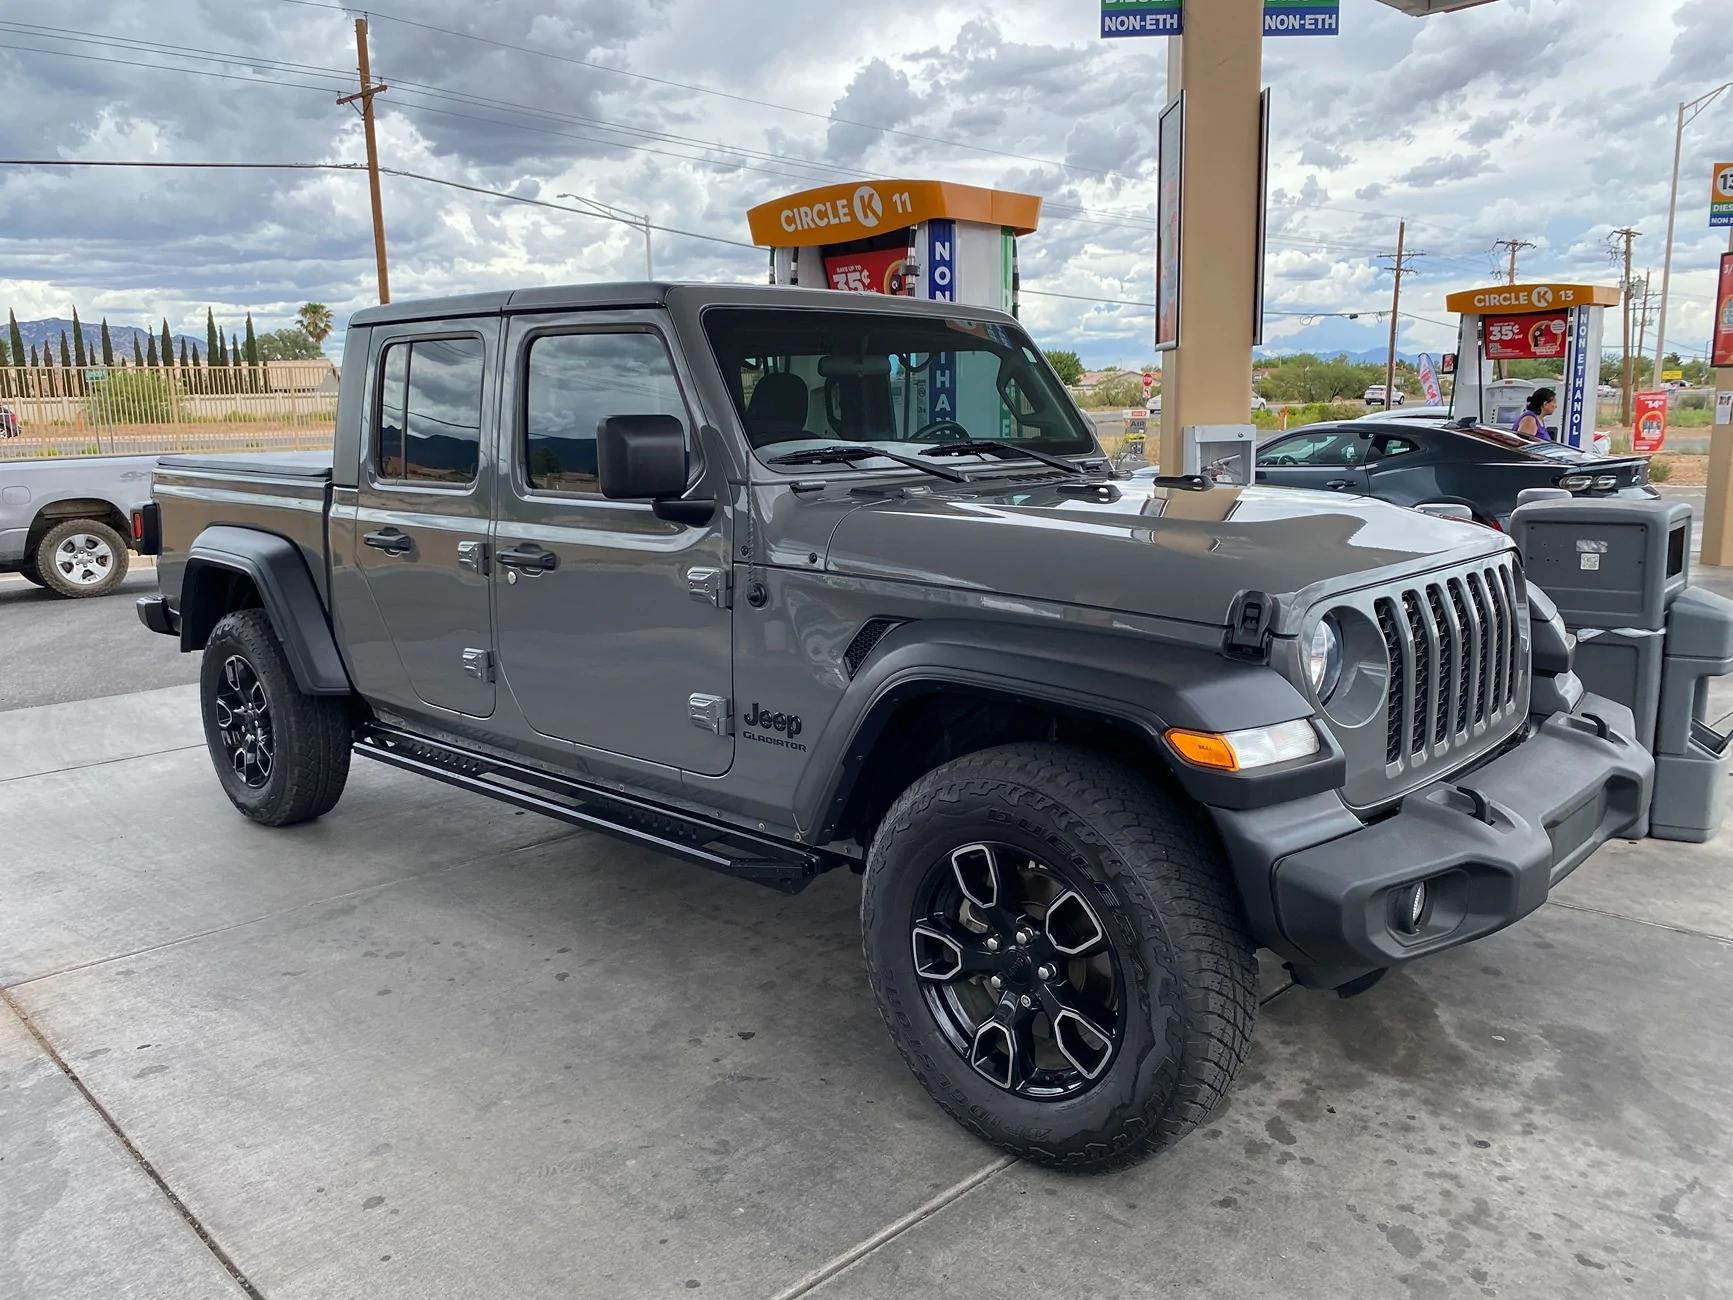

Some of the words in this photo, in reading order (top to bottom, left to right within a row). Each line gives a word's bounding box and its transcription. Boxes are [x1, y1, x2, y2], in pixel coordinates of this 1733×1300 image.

[1104, 14, 1178, 31] NON-ETH
[1264, 14, 1336, 30] NON-ETH
[780, 199, 851, 233] CIRCLE
[892, 191, 913, 214] 11
[1474, 291, 1528, 307] CIRCLE
[1559, 290, 1574, 301] 13
[1579, 314, 1588, 348] NON
[1572, 354, 1585, 435] ETHANOL
[743, 702, 802, 739] Jeep
[743, 731, 807, 753] GLADIATOR
